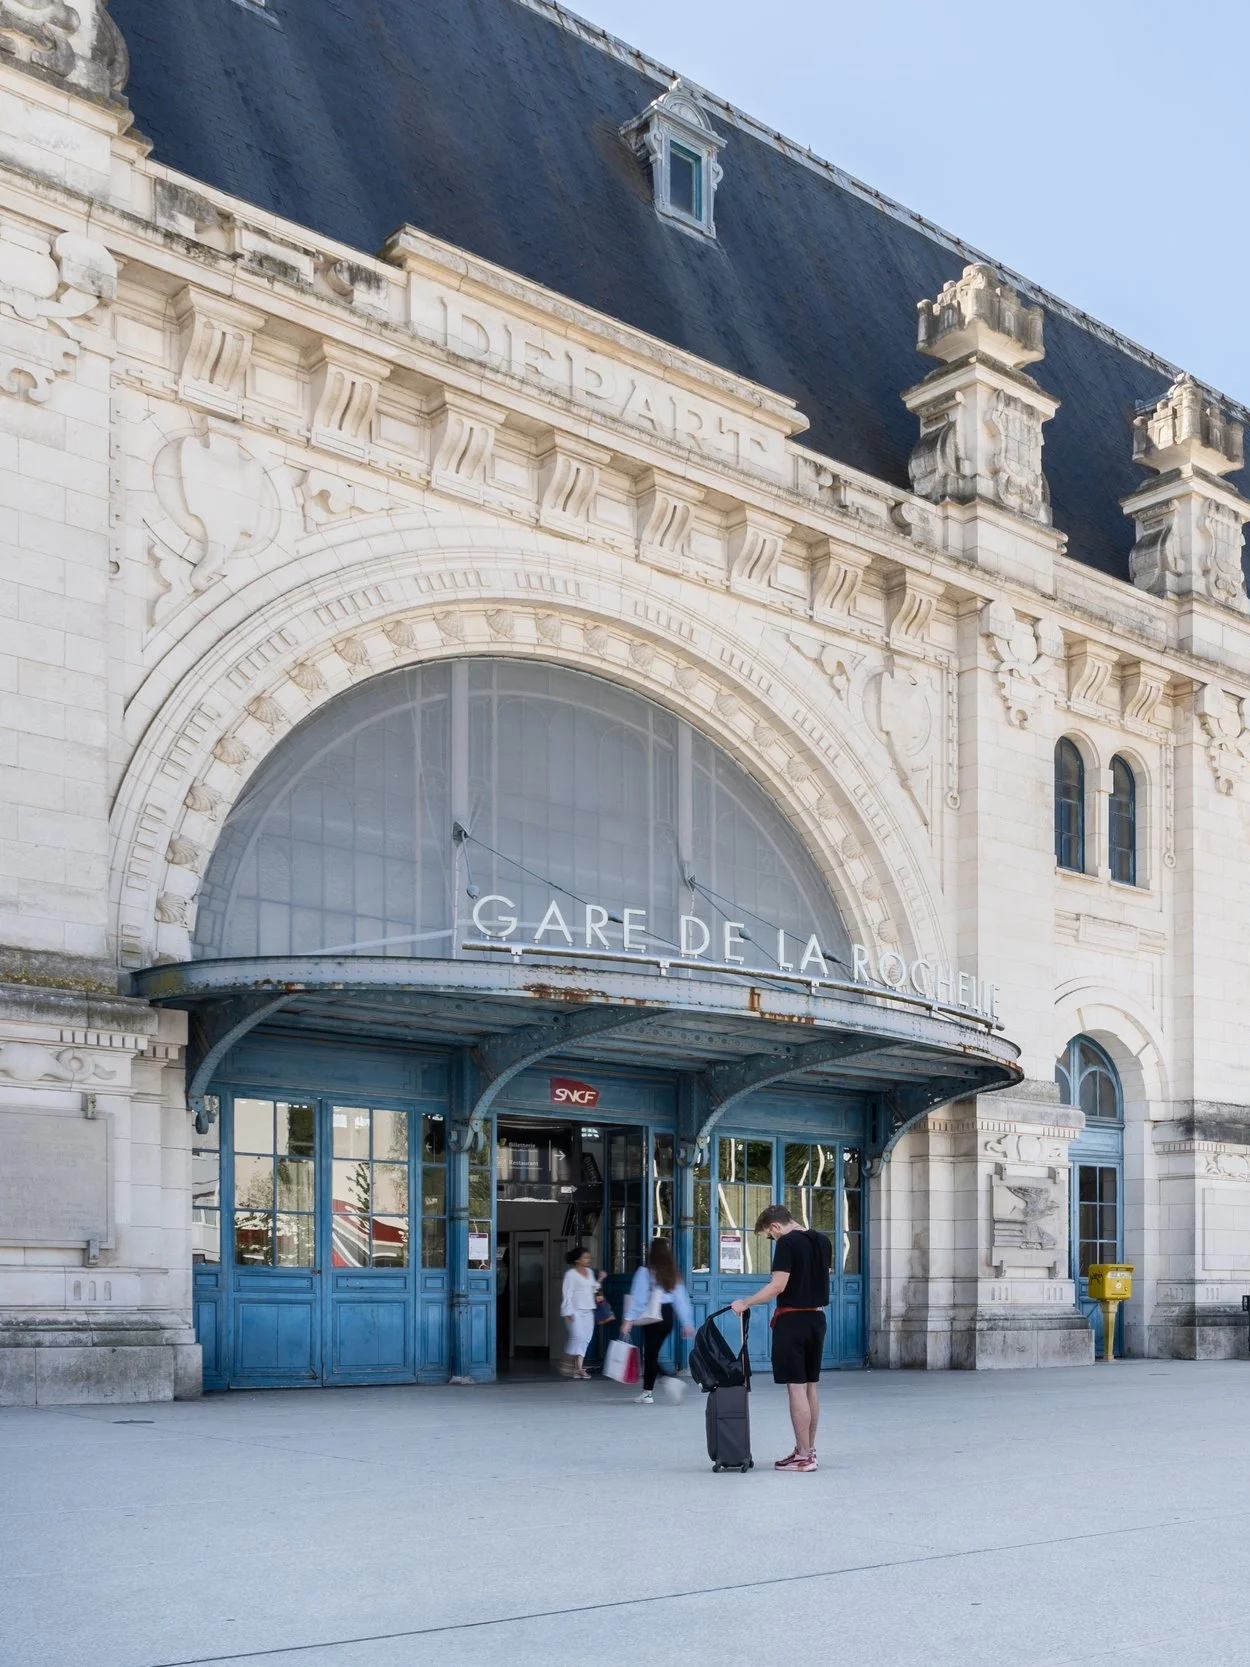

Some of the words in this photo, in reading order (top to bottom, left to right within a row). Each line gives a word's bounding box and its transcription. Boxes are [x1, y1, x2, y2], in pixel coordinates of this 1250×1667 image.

[472, 894, 646, 952] GARE
[680, 914, 746, 962] DE
[778, 928, 830, 972] LA
[852, 942, 1001, 1018] ROCHELLE
[553, 1088, 597, 1104] SNCF
